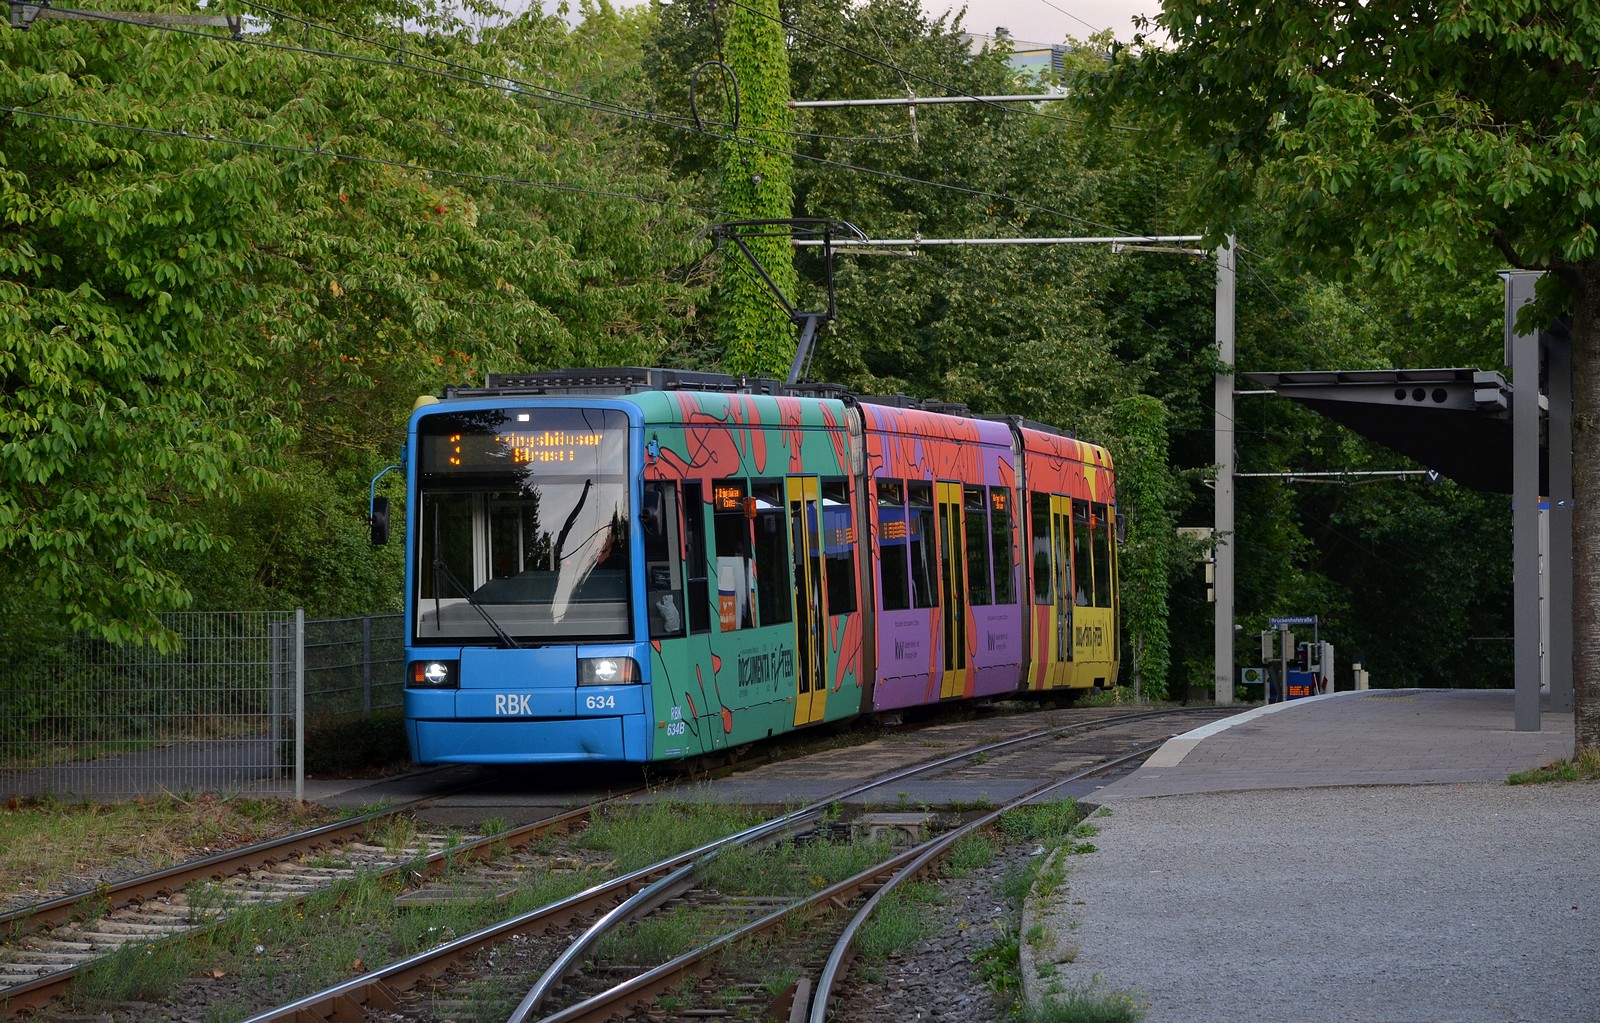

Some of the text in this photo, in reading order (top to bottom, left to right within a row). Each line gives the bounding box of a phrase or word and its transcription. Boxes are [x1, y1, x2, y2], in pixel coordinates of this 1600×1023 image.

[495, 694, 533, 715] RBK
[586, 695, 616, 709] 634
[670, 706, 683, 720] RBK
[666, 722, 686, 736] 634B
